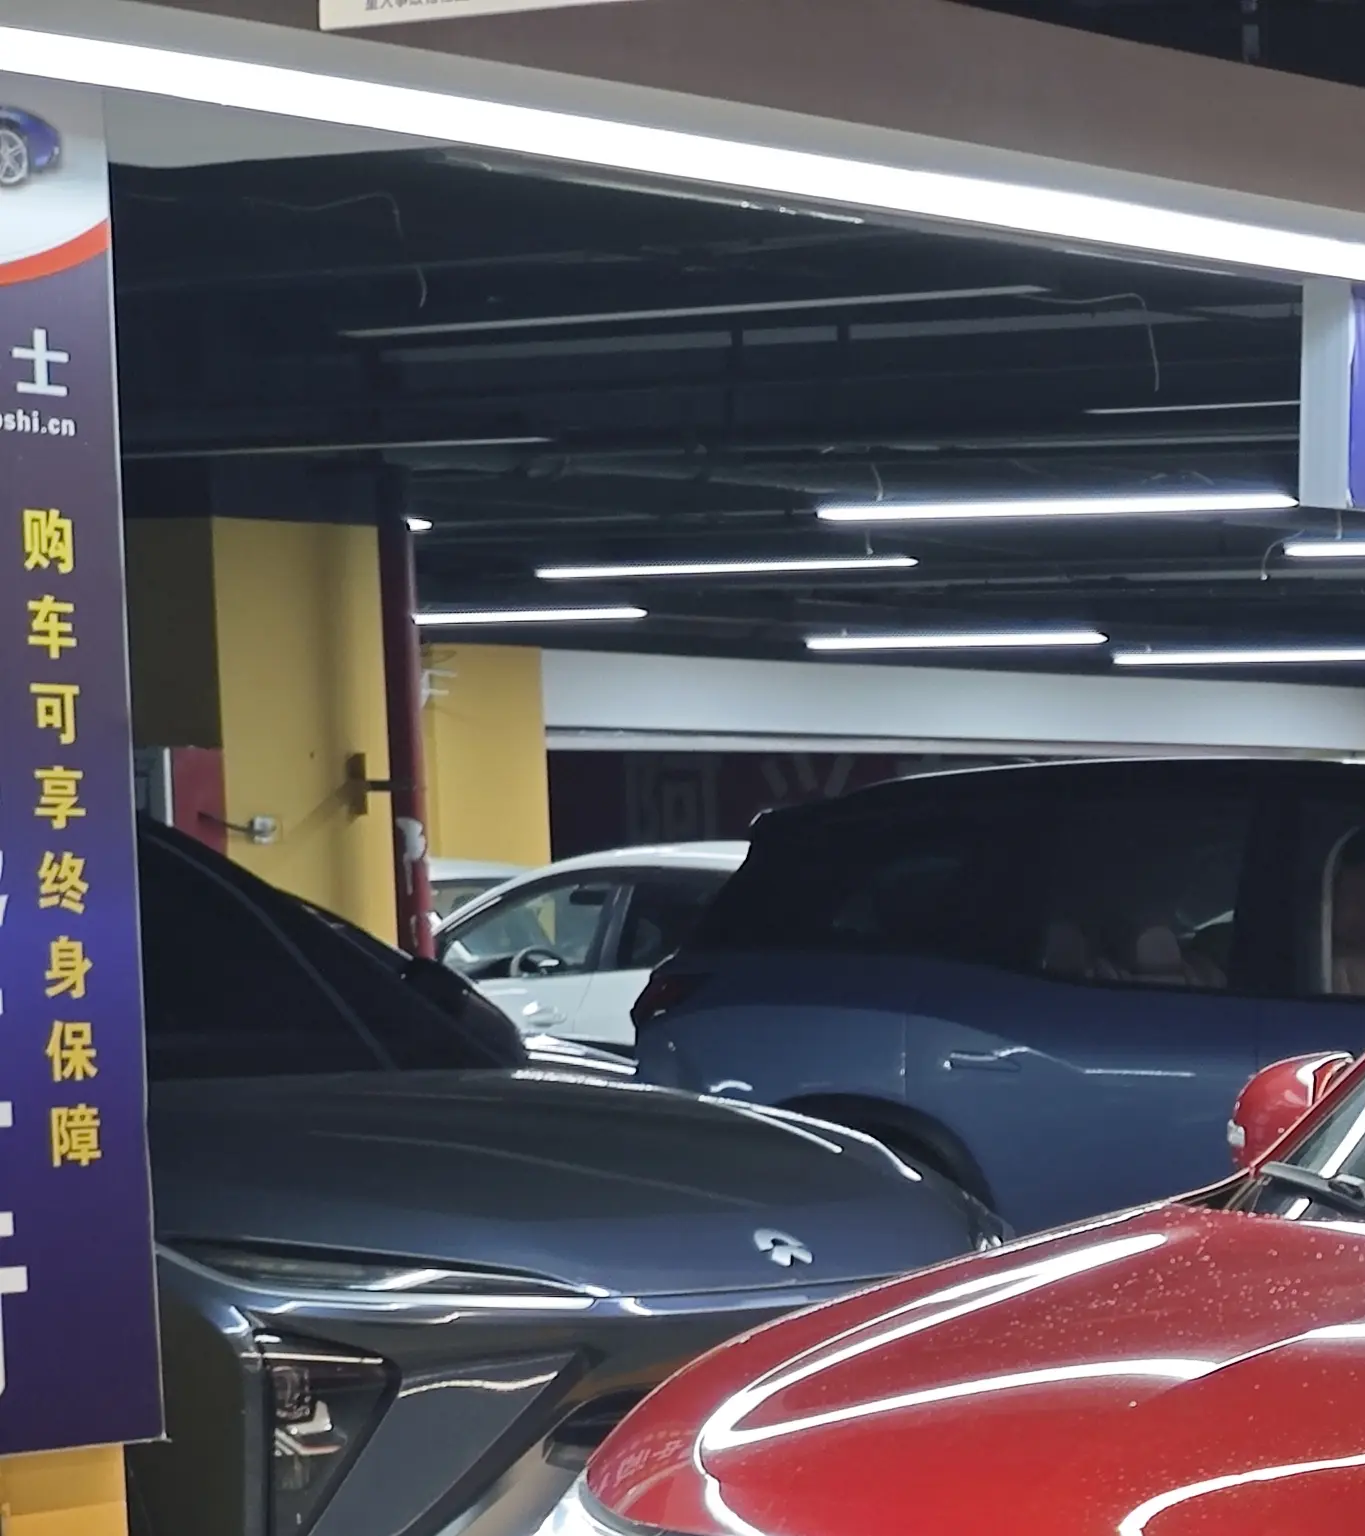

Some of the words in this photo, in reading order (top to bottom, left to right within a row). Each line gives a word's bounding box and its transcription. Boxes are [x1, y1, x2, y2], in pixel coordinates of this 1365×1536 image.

[12, 328, 69, 396] 士
[23, 508, 102, 1168] 购车可享终身保障
